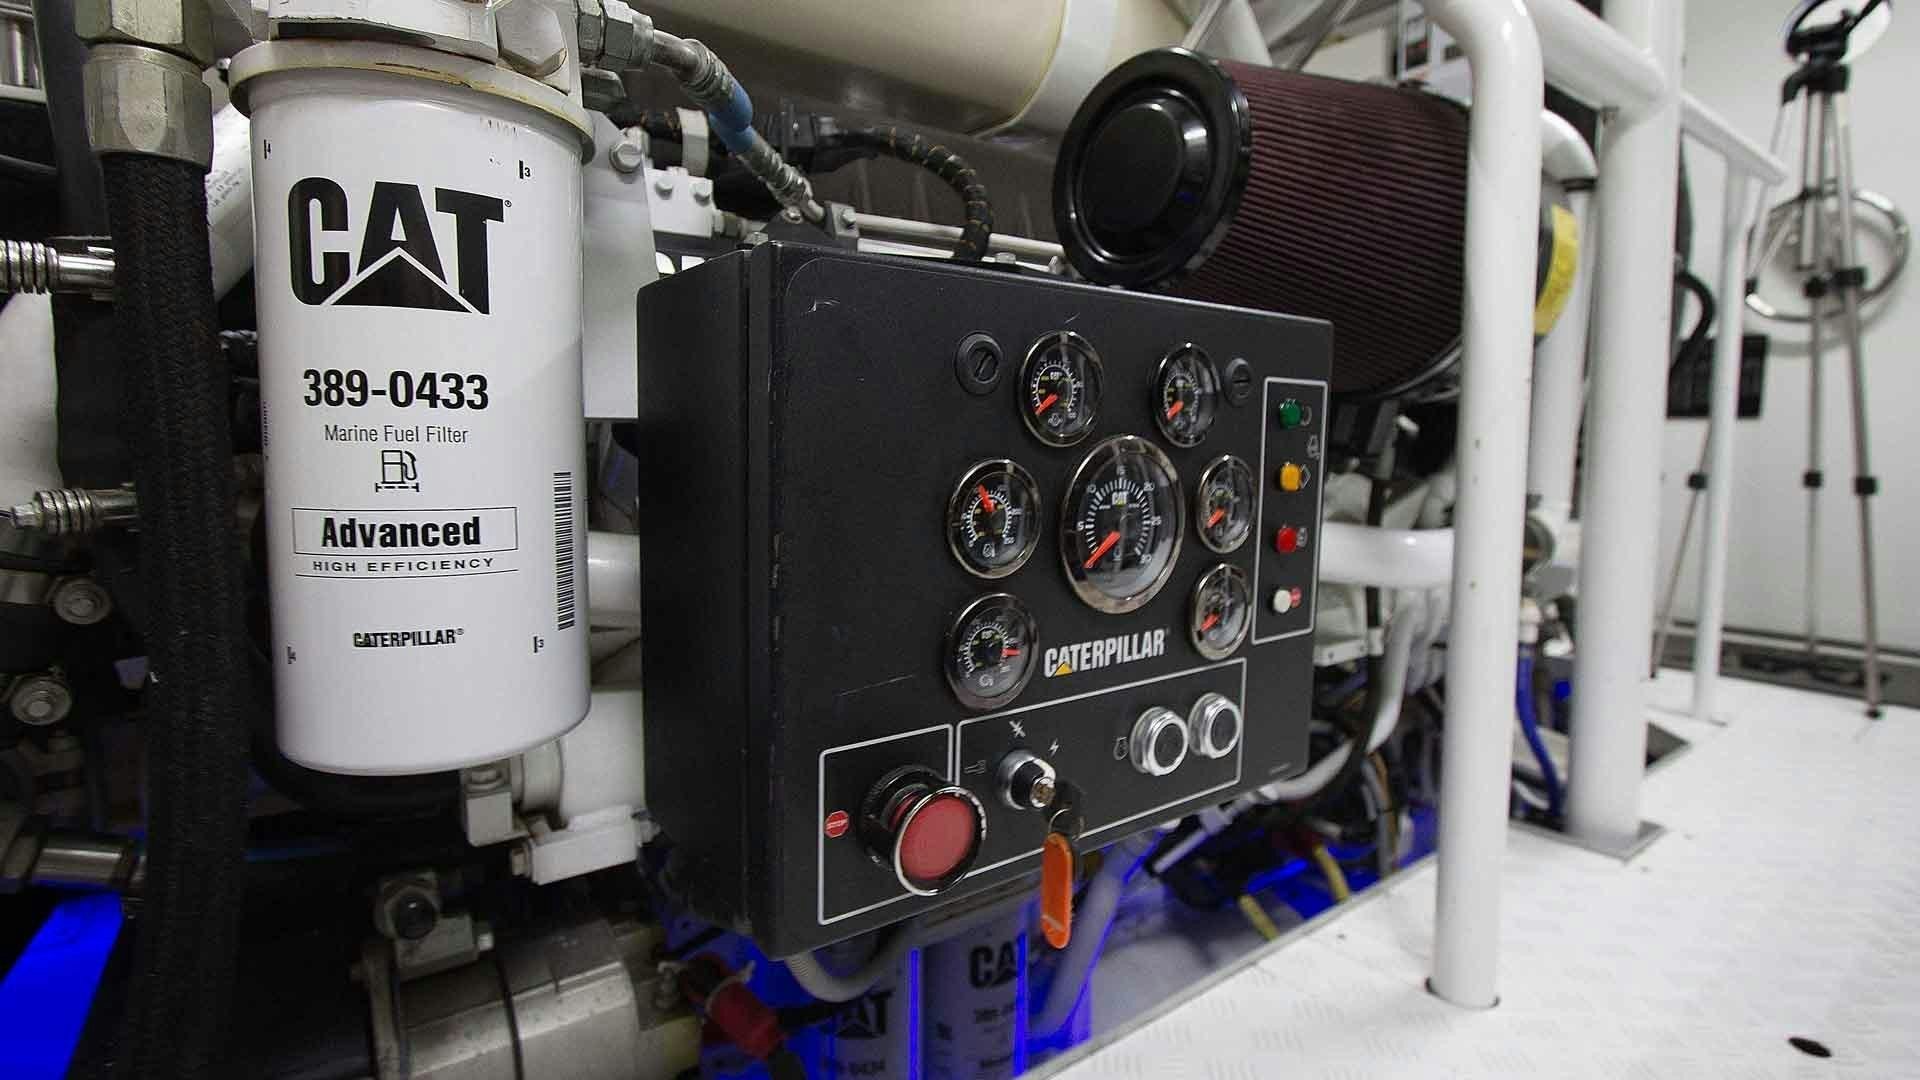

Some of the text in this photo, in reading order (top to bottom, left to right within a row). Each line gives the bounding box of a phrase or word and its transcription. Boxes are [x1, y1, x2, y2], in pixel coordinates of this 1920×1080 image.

[303, 368, 489, 411] 389-0433
[324, 424, 469, 444] Marine Fuel Filter
[321, 516, 482, 548] Advanced
[312, 557, 495, 573] HIGH EFFICIENCY
